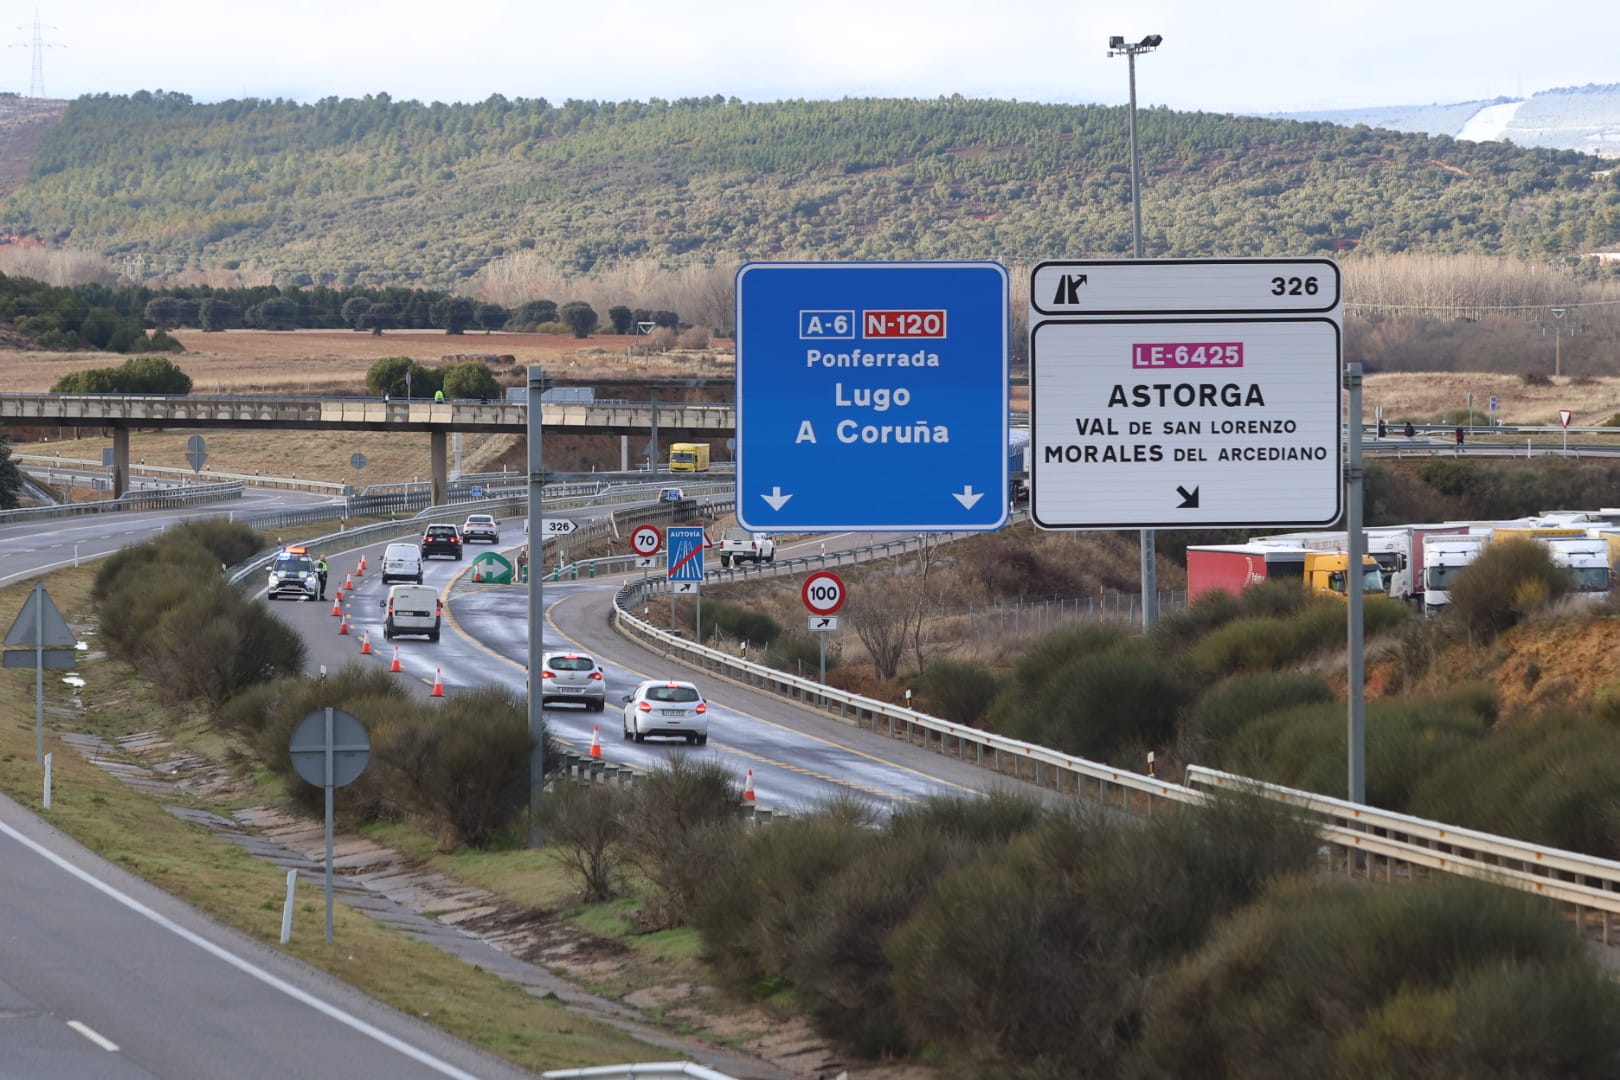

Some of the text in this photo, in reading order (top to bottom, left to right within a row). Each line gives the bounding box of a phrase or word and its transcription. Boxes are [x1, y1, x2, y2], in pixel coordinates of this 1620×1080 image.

[1271, 276, 1319, 296] 326
[807, 315, 848, 334] A-6
[868, 314, 941, 335] N-120
[807, 348, 940, 368] Ponferrada
[1136, 345, 1239, 366] LE-6425
[835, 382, 911, 412] Lugo
[1107, 383, 1265, 408] ASTORGA
[795, 419, 950, 444] A Coruña
[1075, 417, 1297, 436] VAL DE SAN LORENZO
[1045, 444, 1327, 464] MORALES DEL ARCEDIANO
[549, 522, 570, 531] 326
[638, 535, 655, 546] 70
[810, 586, 837, 601] 100
